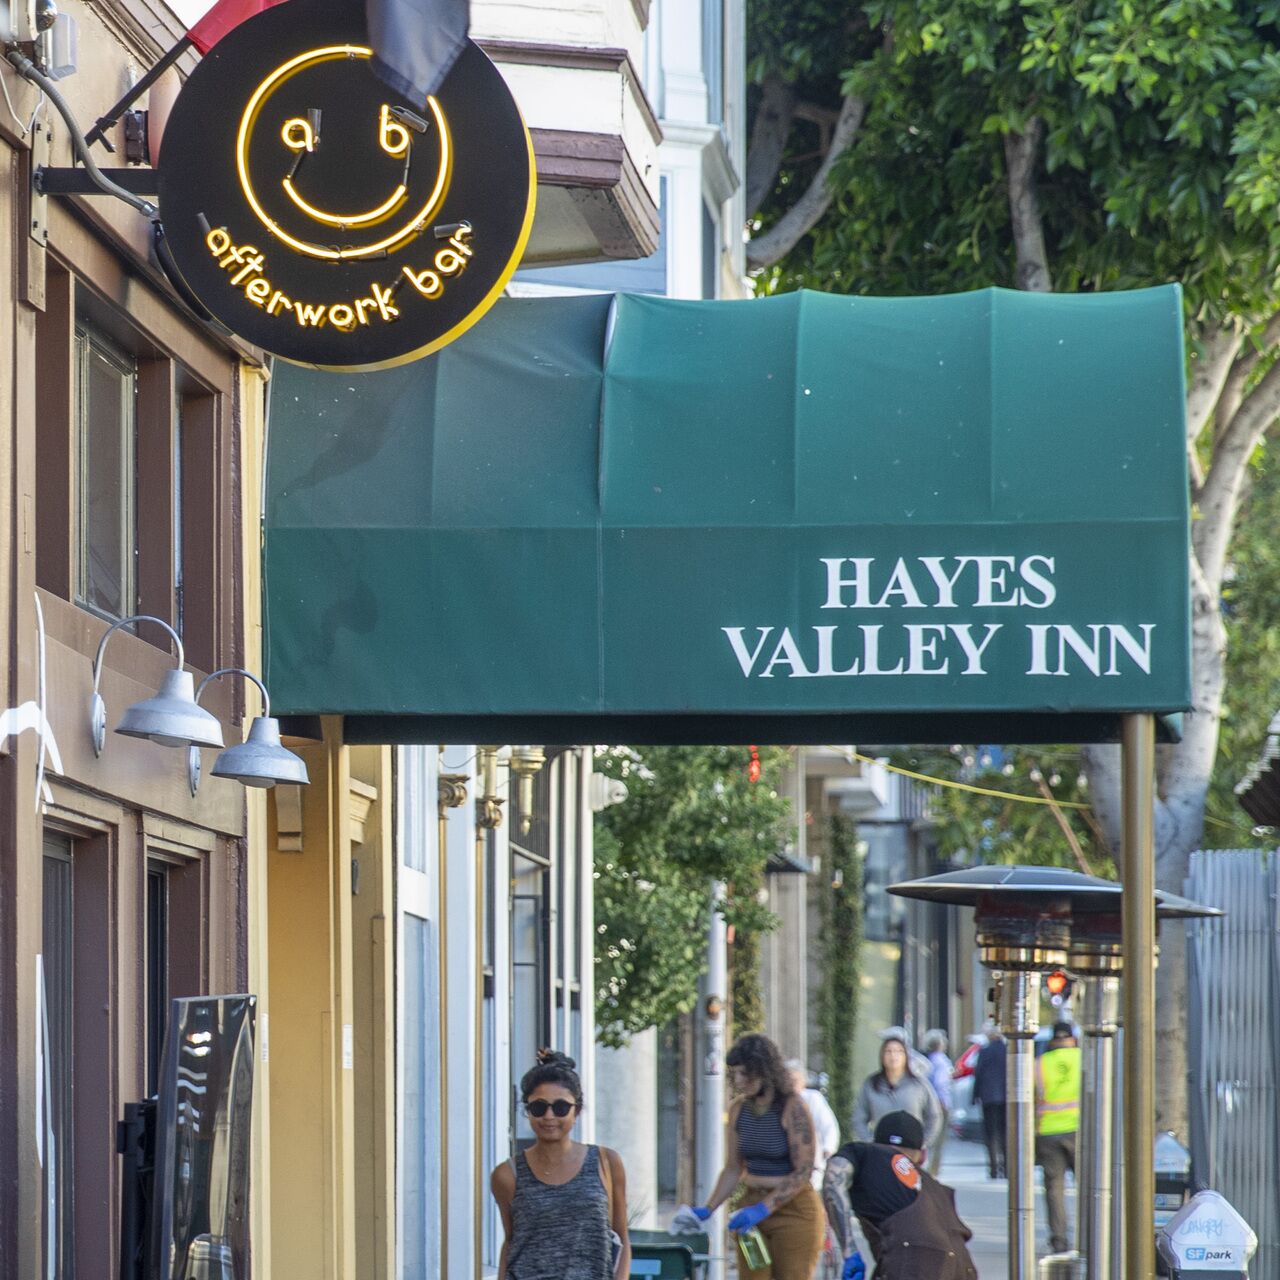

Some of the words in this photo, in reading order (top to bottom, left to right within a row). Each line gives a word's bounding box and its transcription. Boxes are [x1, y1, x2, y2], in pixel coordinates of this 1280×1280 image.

[205, 227, 401, 328] afterwork
[401, 223, 474, 296] bar
[819, 554, 1057, 609] HAYES
[721, 623, 1005, 679] VALLEY
[1025, 623, 1157, 677] INN
